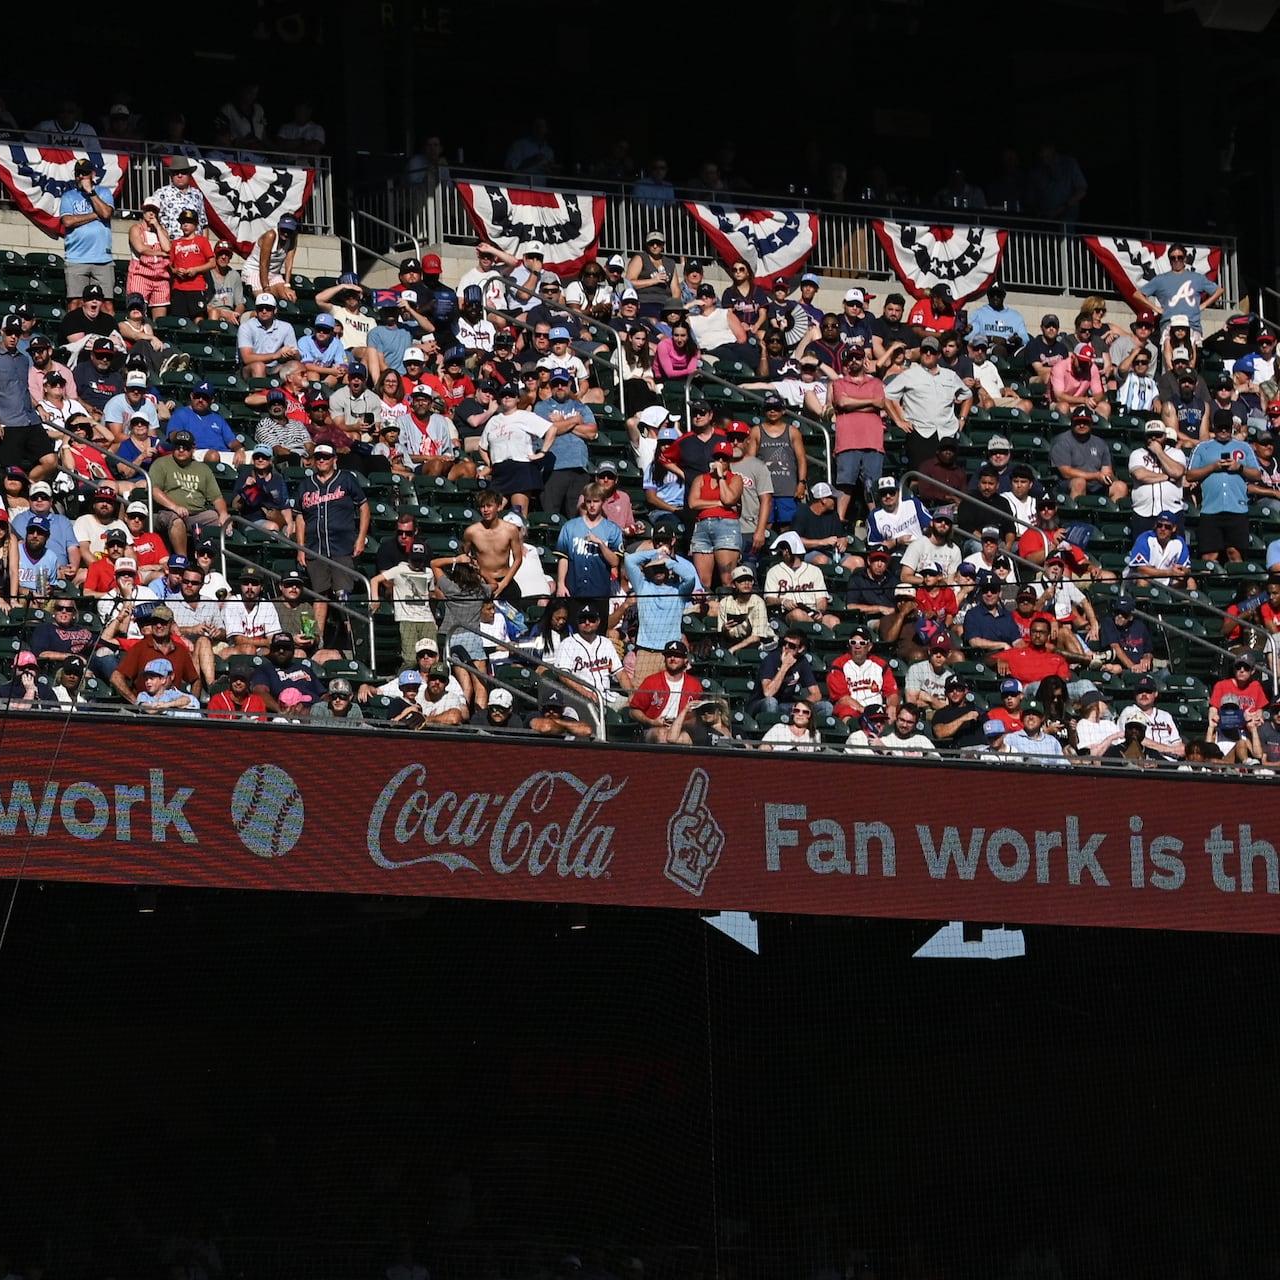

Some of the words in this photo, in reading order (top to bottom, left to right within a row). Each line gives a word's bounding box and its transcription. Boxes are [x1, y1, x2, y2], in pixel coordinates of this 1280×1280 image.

[1169, 280, 1195, 306] A
[366, 762, 628, 880] Coca-Cola
[764, 802, 898, 876] Fan
[916, 815, 1112, 887] work
[1130, 815, 1185, 890] is
